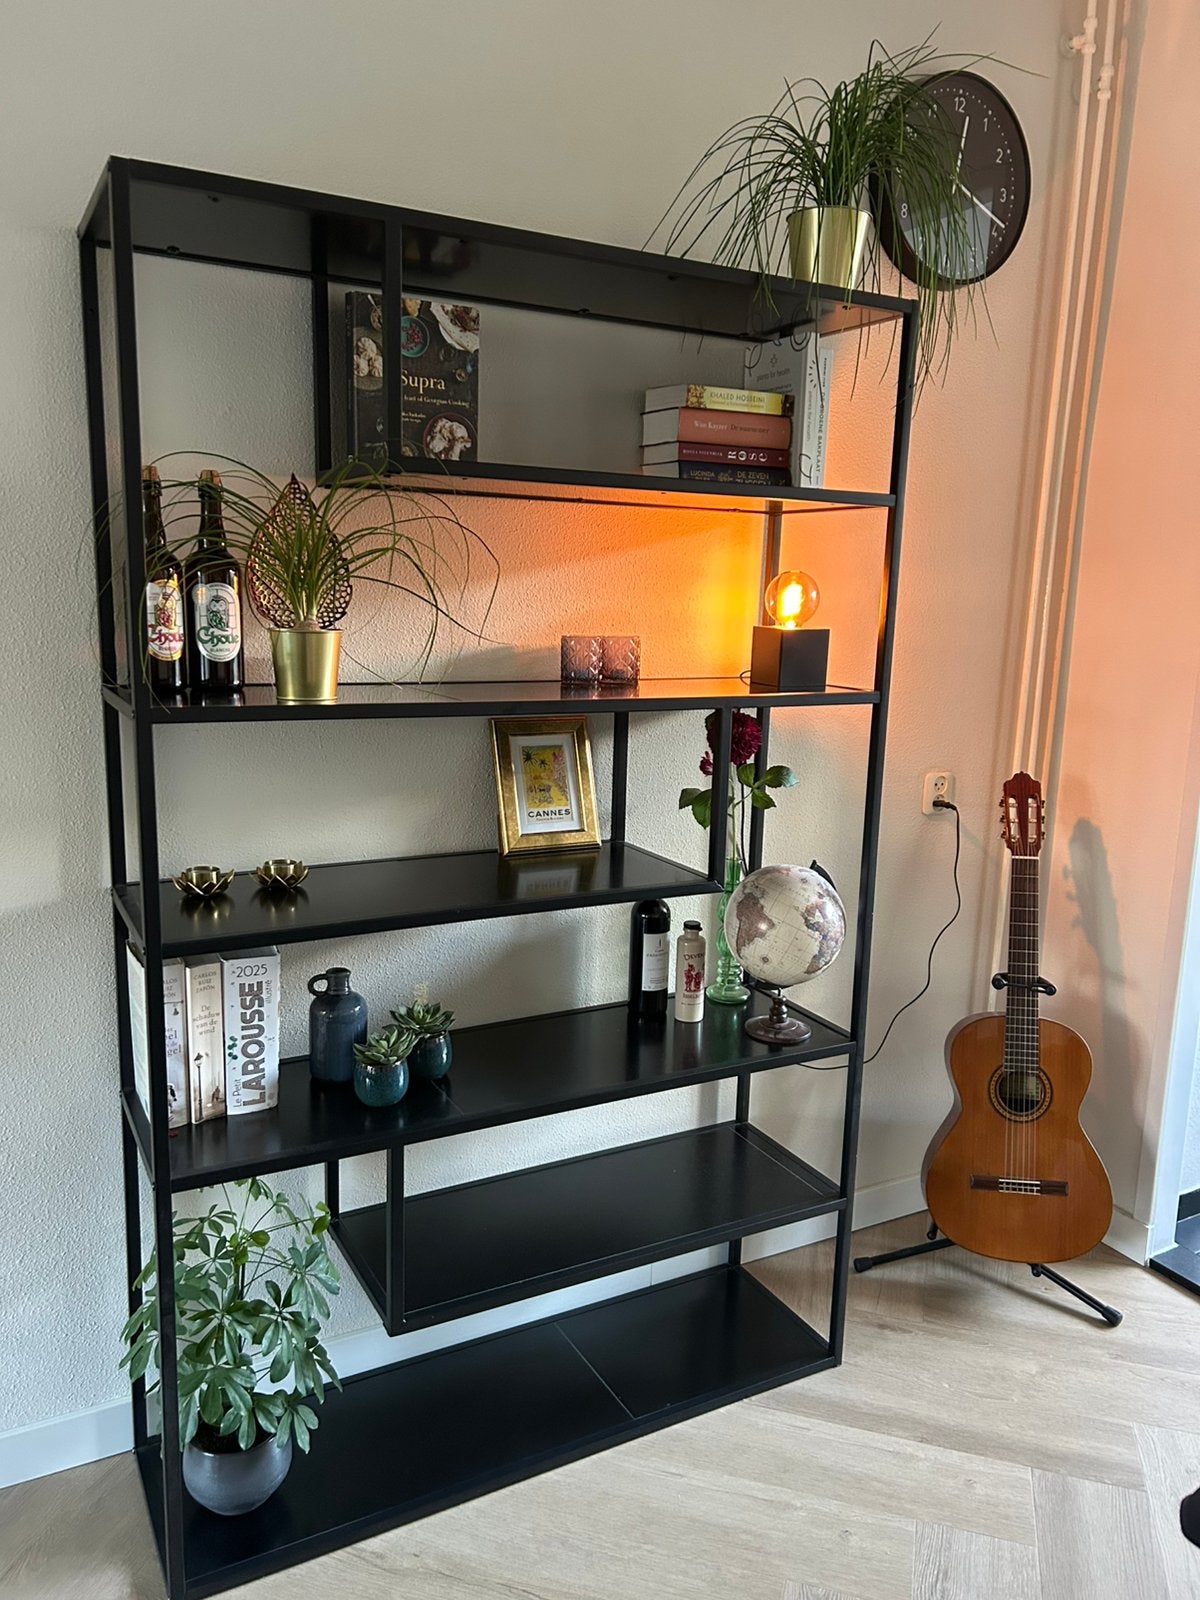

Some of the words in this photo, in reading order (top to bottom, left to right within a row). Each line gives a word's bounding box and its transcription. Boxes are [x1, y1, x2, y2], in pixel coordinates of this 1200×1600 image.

[954, 96, 967, 113] 12
[983, 117, 989, 132] 1
[995, 148, 1003, 164] 2
[999, 188, 1008, 203] 3
[900, 203, 909, 219] 8
[991, 223, 1000, 238] 4
[401, 369, 446, 394] Supra
[710, 391, 734, 401] KHALED
[736, 394, 766, 403] HOSSEINI
[528, 808, 571, 818] CANNES
[193, 970, 217, 980] CARLOS
[236, 963, 268, 978] 2025
[201, 1004, 210, 1012] De
[192, 1011, 221, 1023] schaduw
[196, 1021, 208, 1029] van
[208, 1018, 218, 1027] de
[198, 1027, 216, 1037] wind
[238, 980, 267, 1107] LAROUSSE
[232, 1078, 242, 1096] Petit
[233, 1096, 242, 1108] Le
